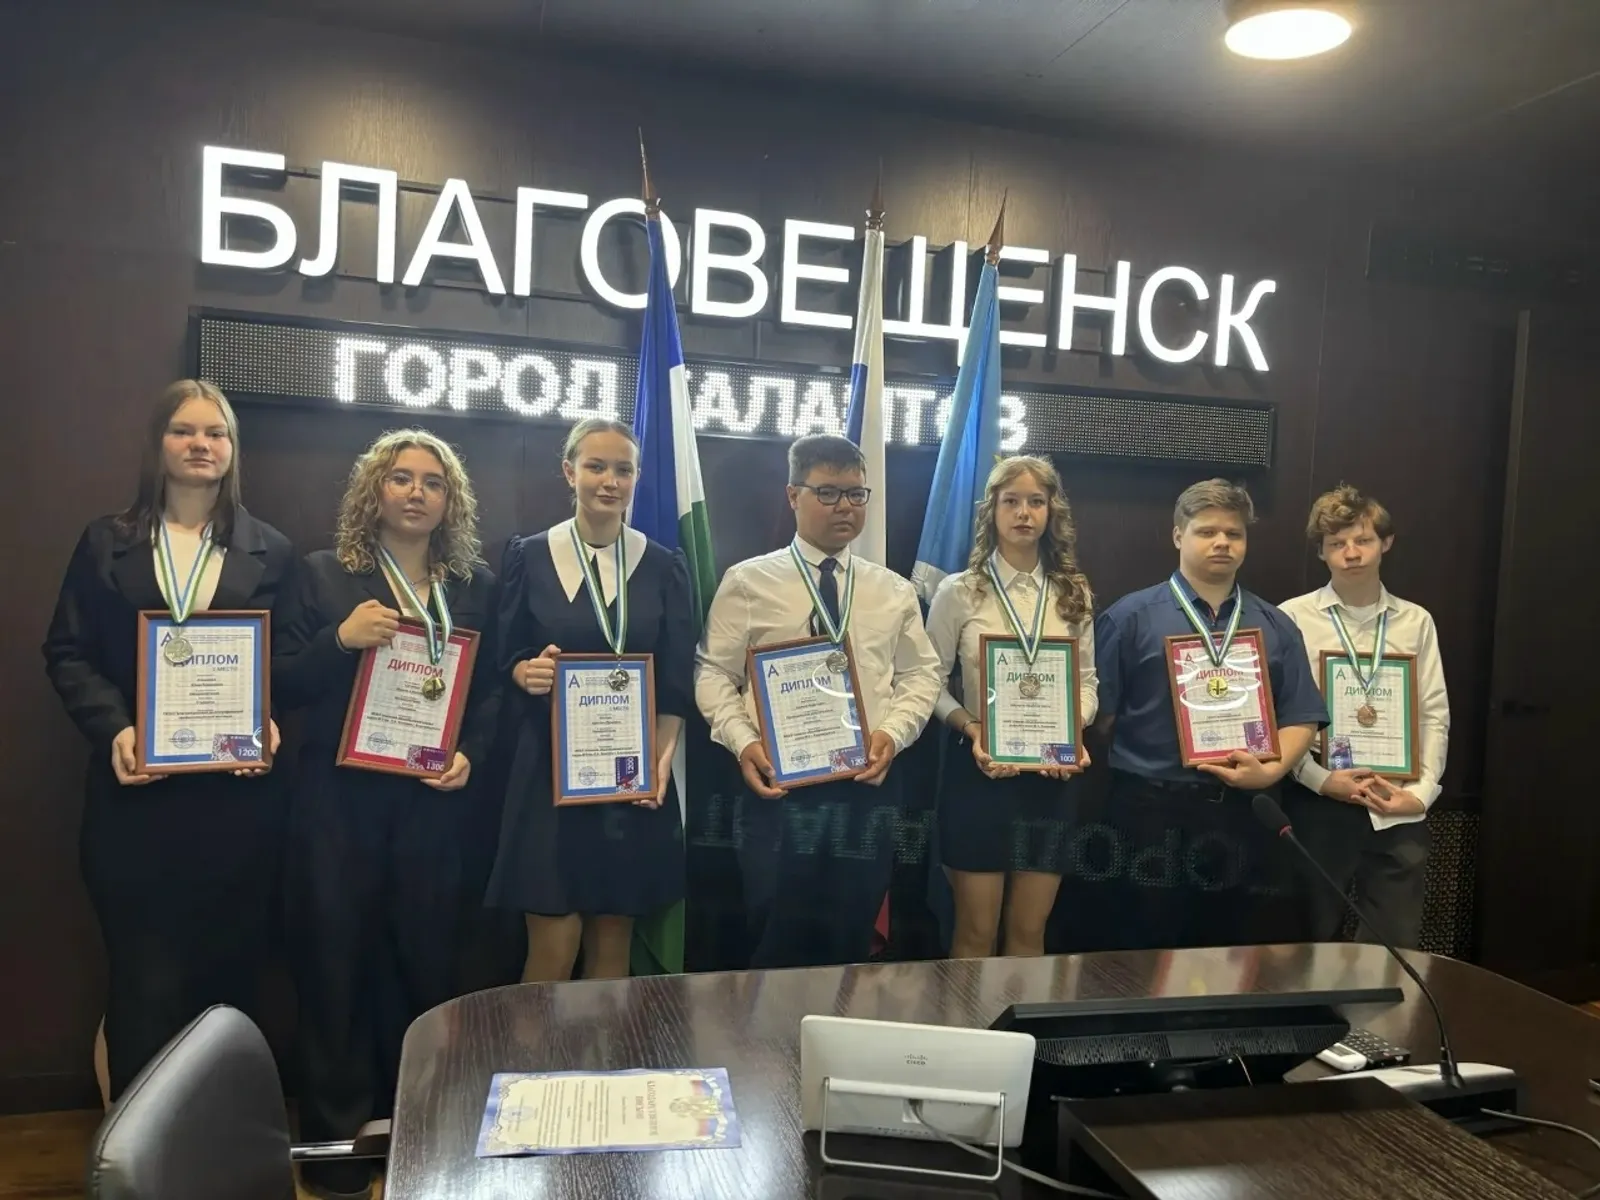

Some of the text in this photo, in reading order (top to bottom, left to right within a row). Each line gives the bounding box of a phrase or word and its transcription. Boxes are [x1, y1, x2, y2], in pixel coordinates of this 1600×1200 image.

[200, 145, 1277, 372] БЛАГОВЕЩЕНСК
[336, 337, 619, 421] ГОРОД
[173, 654, 239, 667] ИПЛОМ
[997, 652, 1008, 665] А
[387, 659, 444, 677] ДИПЛОМ
[768, 664, 779, 677] А
[1335, 668, 1346, 680] А
[568, 674, 580, 688] А
[781, 675, 832, 694] ДИПЛОМ
[579, 694, 630, 707] ДИПЛОМ
